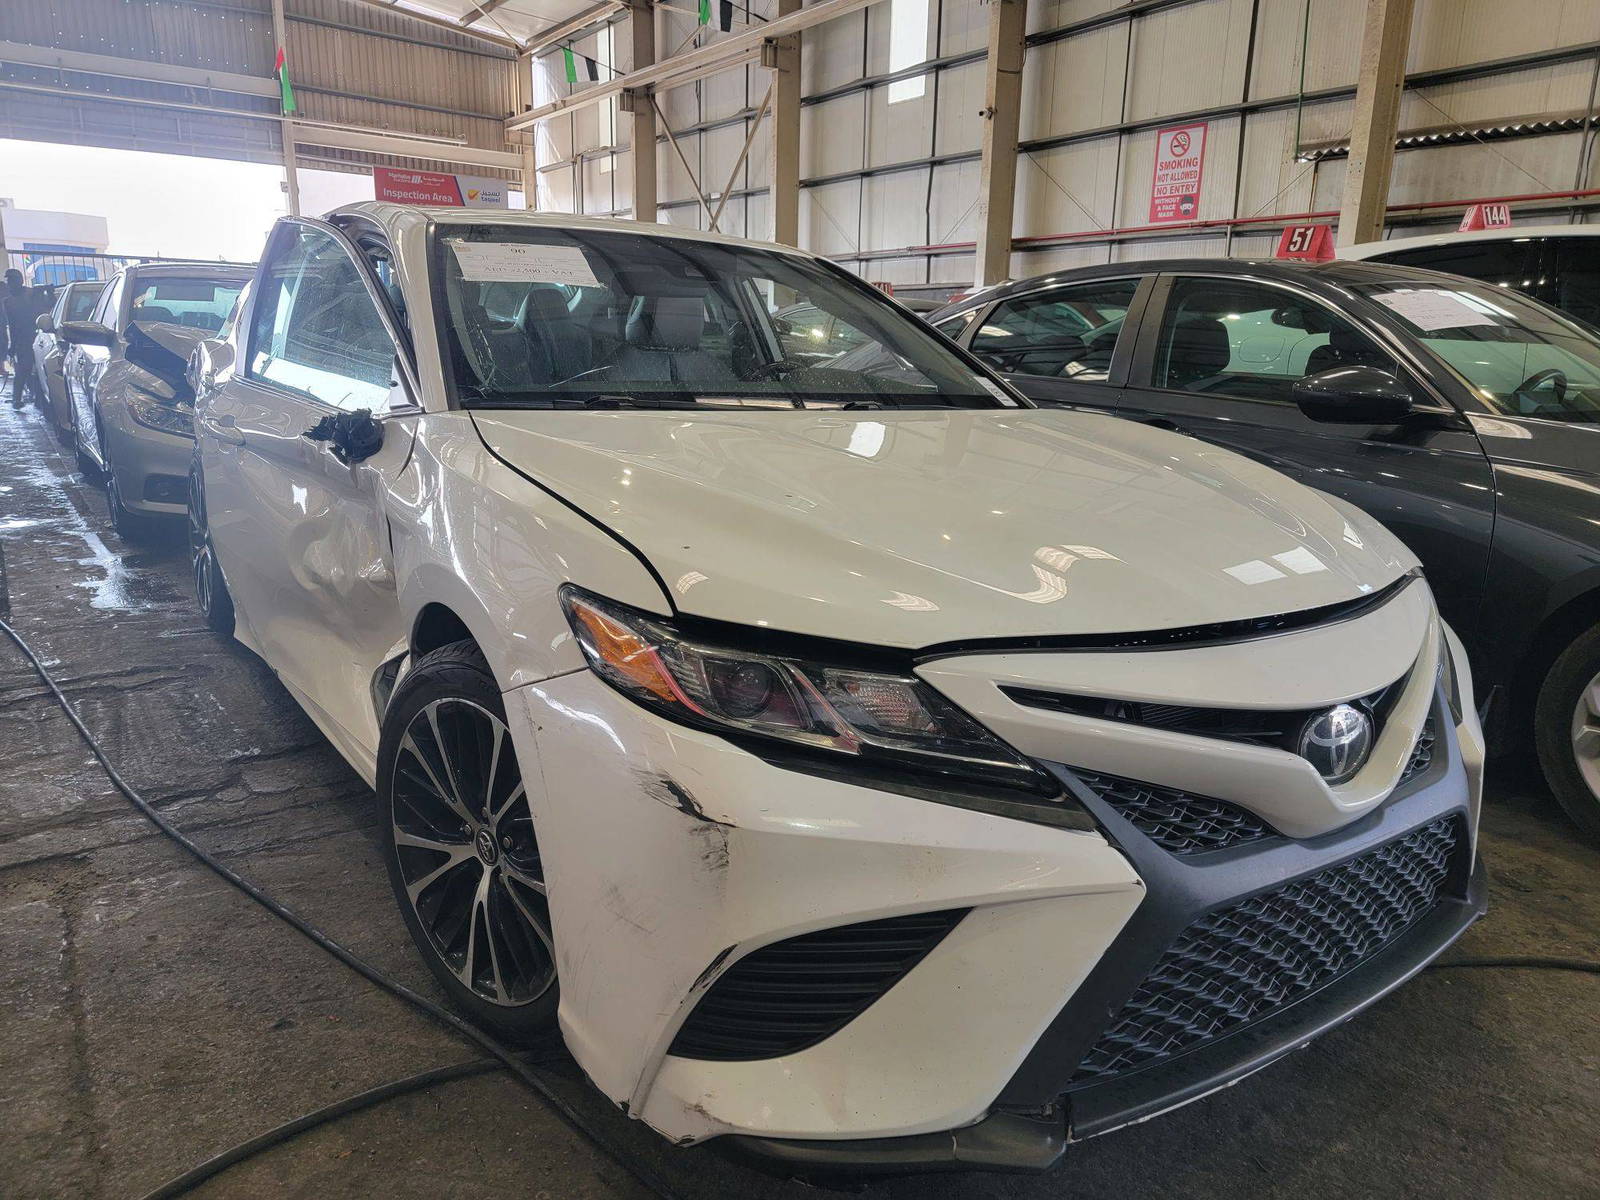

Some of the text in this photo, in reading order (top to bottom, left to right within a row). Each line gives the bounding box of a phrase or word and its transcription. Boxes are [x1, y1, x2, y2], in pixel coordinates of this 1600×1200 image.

[1159, 157, 1198, 171] SMOKING
[1157, 170, 1198, 183] NOT ALLOWED
[383, 187, 453, 203] Inspection Area
[1156, 183, 1196, 195] NO ENTRY
[1486, 206, 1507, 225] 144
[1289, 227, 1315, 252] 51
